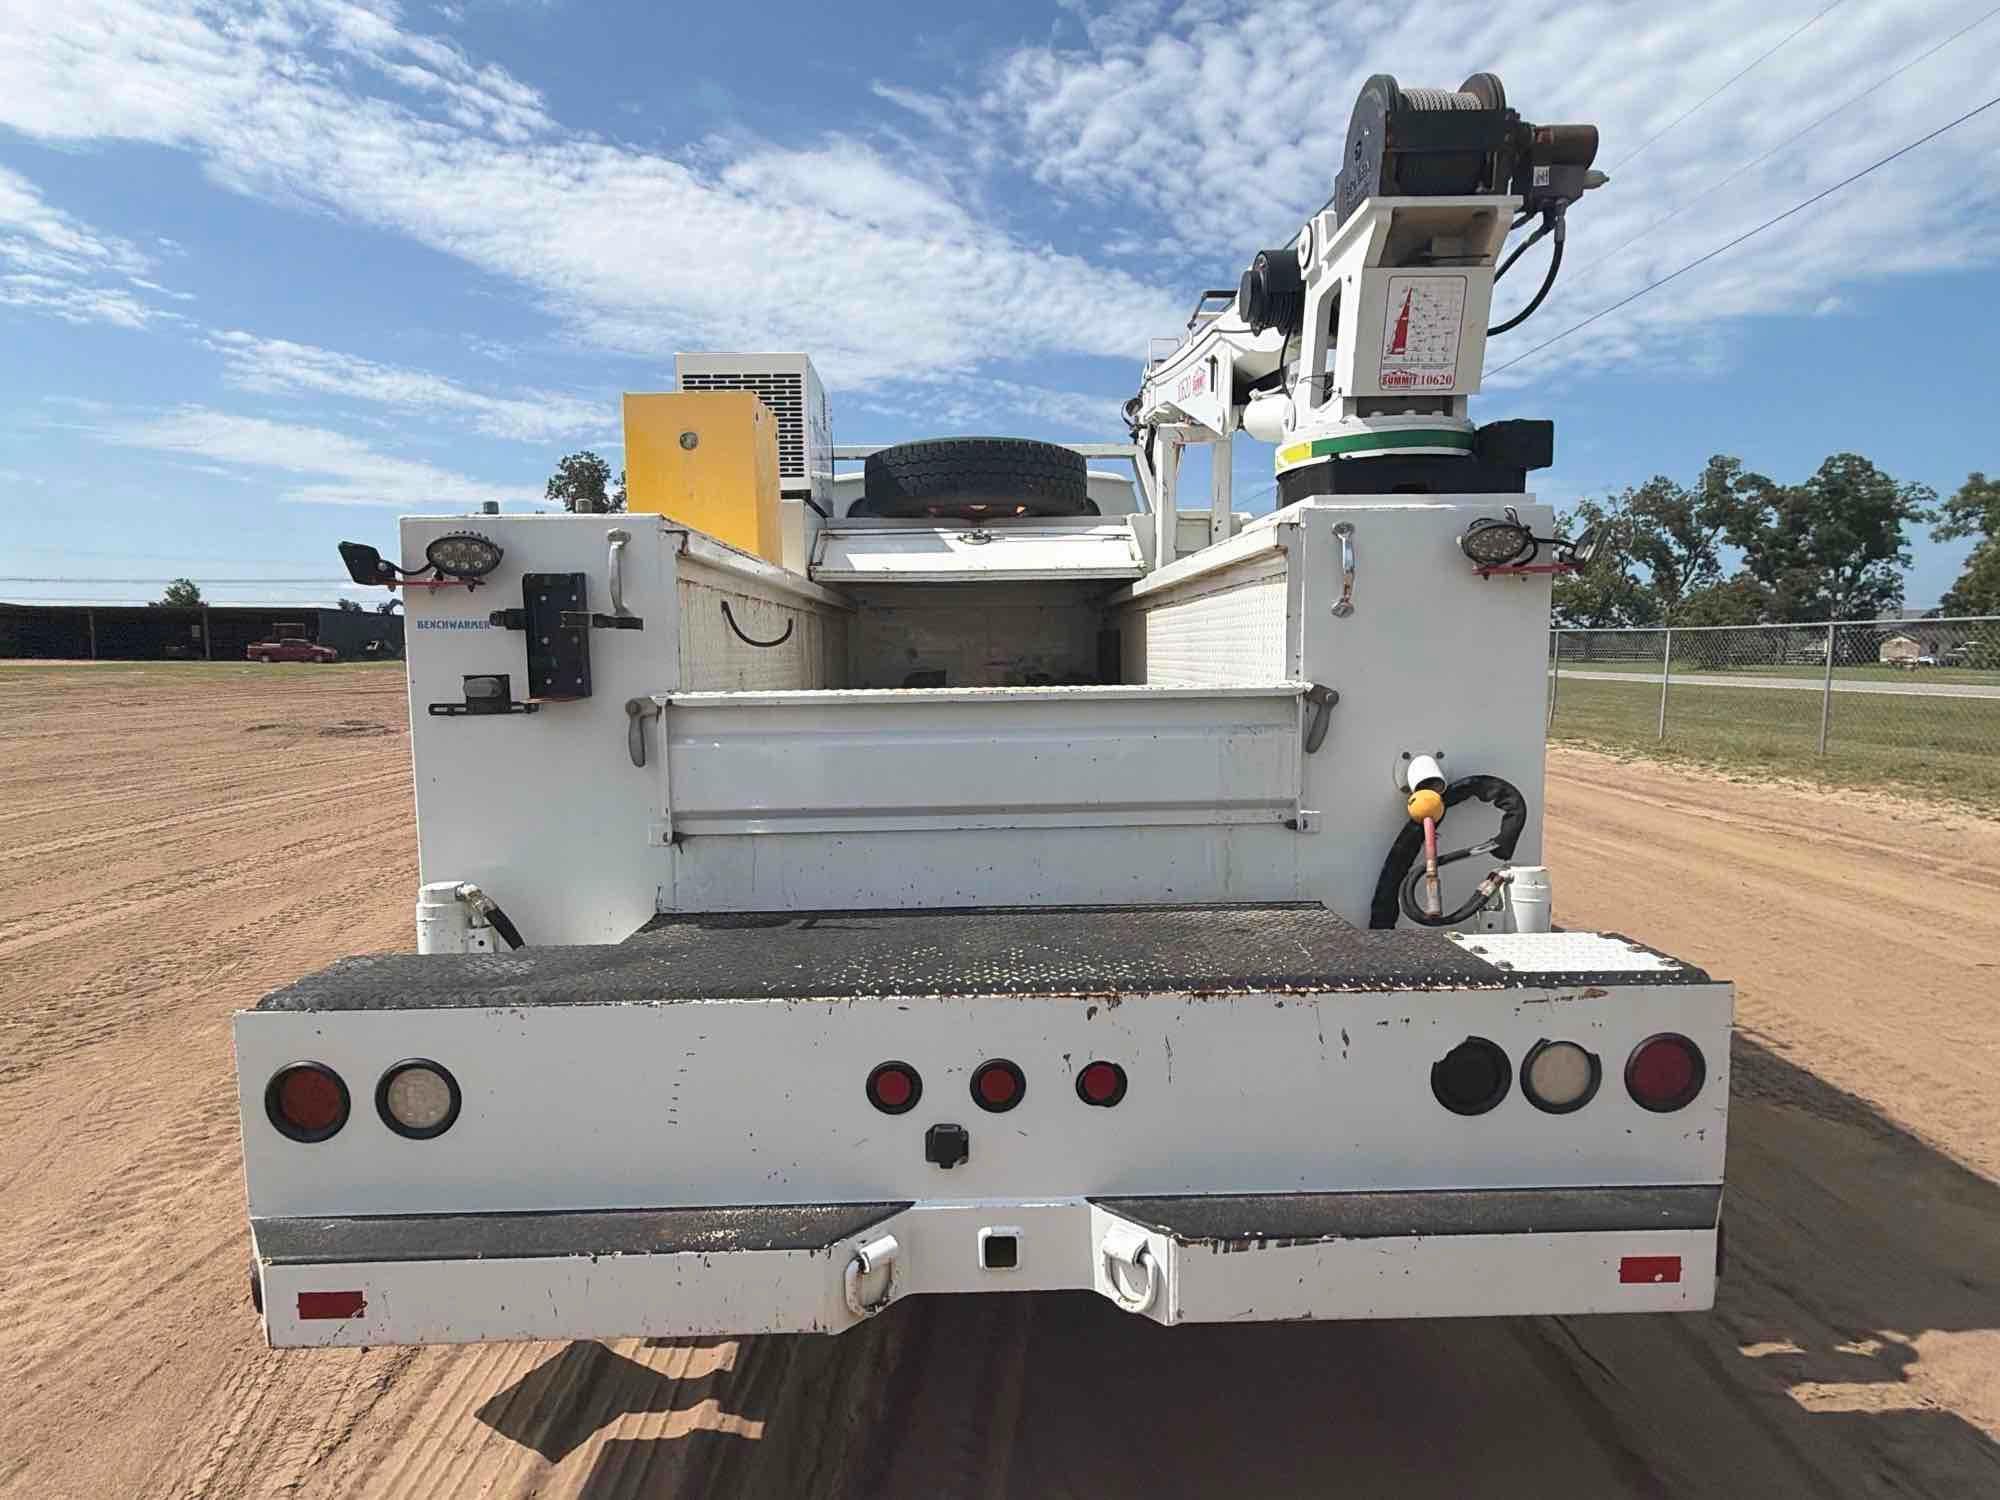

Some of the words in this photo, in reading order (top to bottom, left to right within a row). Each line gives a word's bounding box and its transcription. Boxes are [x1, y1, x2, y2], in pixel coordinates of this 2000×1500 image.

[1382, 375, 1418, 386] SUMMIT
[1421, 374, 1453, 385] 10620
[416, 619, 490, 630] BENCHWARMER
